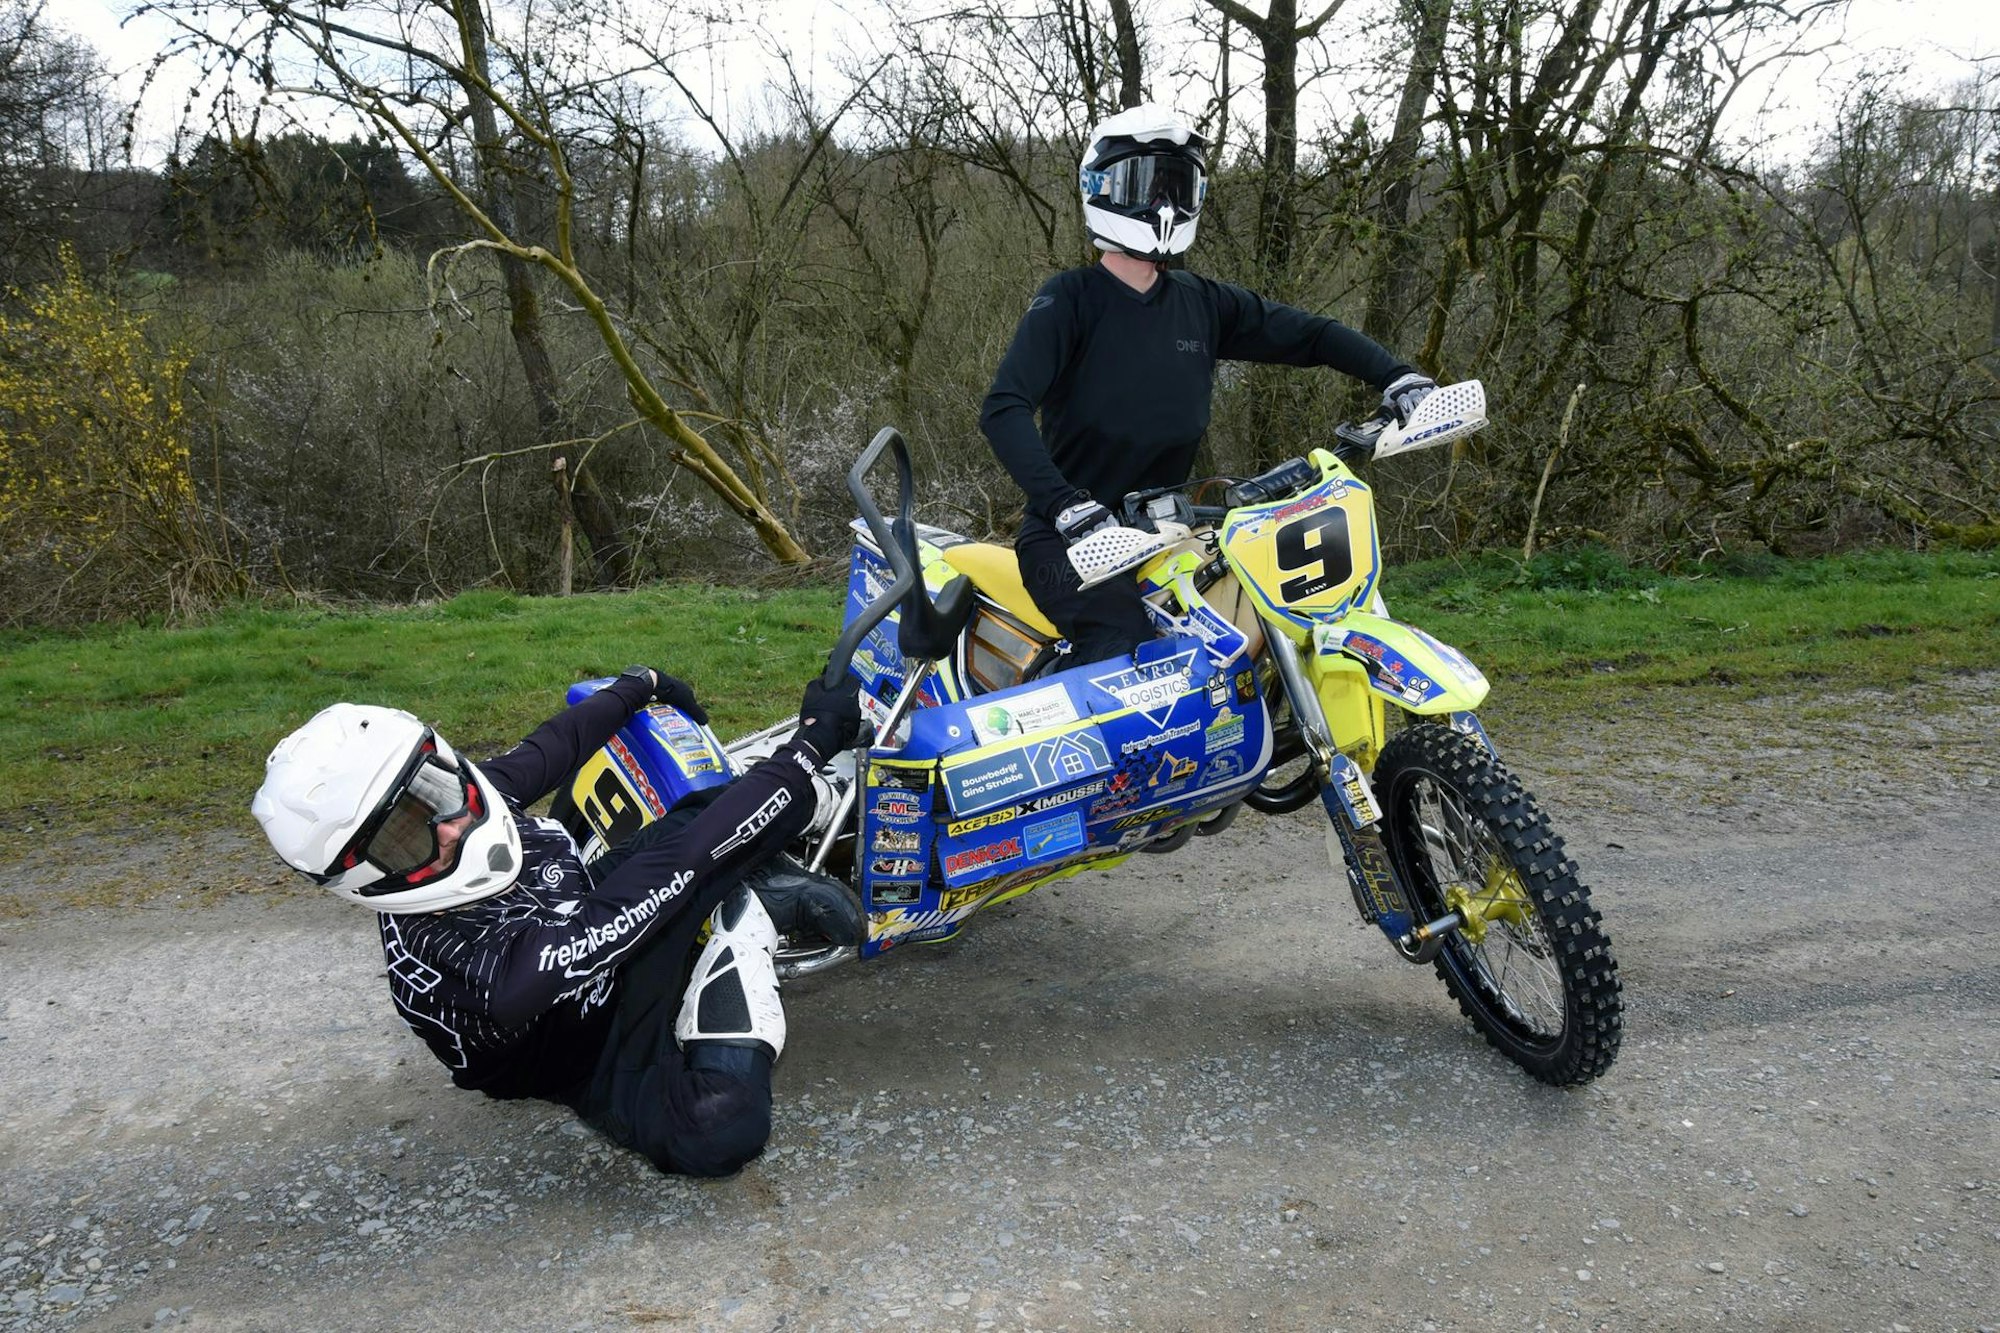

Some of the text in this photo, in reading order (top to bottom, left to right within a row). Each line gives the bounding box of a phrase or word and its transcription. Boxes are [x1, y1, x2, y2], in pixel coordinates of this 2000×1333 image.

[1401, 419, 1463, 446] ACERBIS
[1107, 542, 1166, 574] ACERBIS
[1276, 505, 1353, 605] 9
[1121, 661, 1176, 688] EURO
[1122, 677, 1191, 708] LOGISTICS
[961, 763, 1018, 788] Bouwbedrijf
[962, 772, 1024, 798] Gino Strubbe
[584, 767, 645, 849] 9
[748, 795, 787, 835] Lück
[950, 810, 1014, 835] ACERBIS
[1042, 780, 1105, 808] MOUSSE
[945, 836, 1022, 872] DENICOL
[538, 869, 695, 972] freizitschmiede
